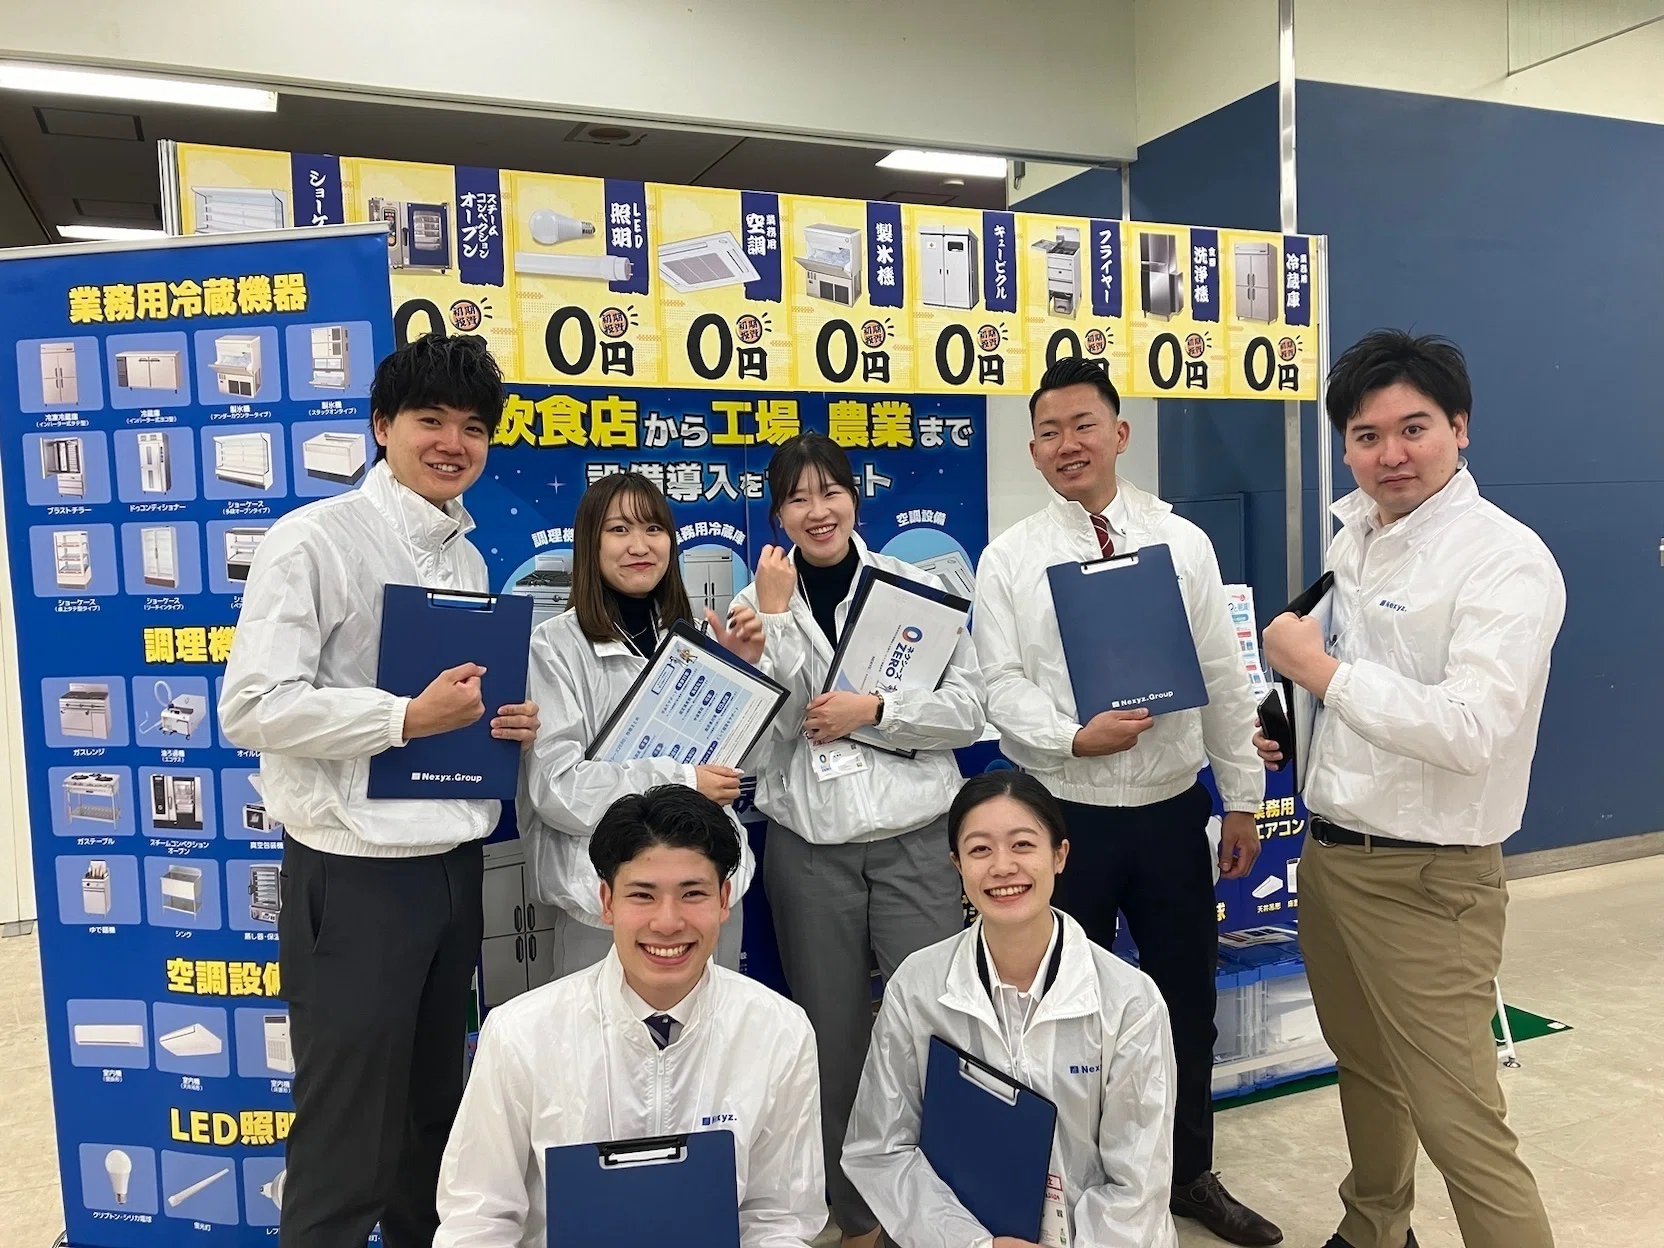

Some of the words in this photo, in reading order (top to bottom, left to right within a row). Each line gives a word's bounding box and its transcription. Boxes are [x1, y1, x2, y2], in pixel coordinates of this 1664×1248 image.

[460, 191, 478, 259] オーブン
[609, 202, 632, 249] 照明
[632, 202, 644, 249] LED
[745, 212, 766, 256] 空調
[876, 222, 896, 287] 製氷機
[993, 224, 1008, 301] キュービクル
[1099, 228, 1115, 305] フライヤー
[1193, 245, 1210, 304] 洗浄機
[1285, 252, 1301, 308] 冷蔵庫
[68, 272, 309, 325] 業務用冷蔵機器
[228, 500, 264, 509] ショーケース
[896, 508, 947, 528] 空調設備
[58, 598, 97, 606] ショーケース
[146, 597, 181, 605] ショーケース
[885, 642, 908, 678] ZERO
[894, 646, 915, 681] ネクシーズ
[1120, 690, 1175, 707] Nexyz.Group
[73, 748, 106, 756] ガスレンジ
[421, 772, 483, 783] Nexyz.Group
[77, 837, 116, 846] ガステーブル
[149, 838, 210, 849] スチームコンベクション
[167, 847, 191, 856] オーブン
[175, 931, 193, 939] シンク
